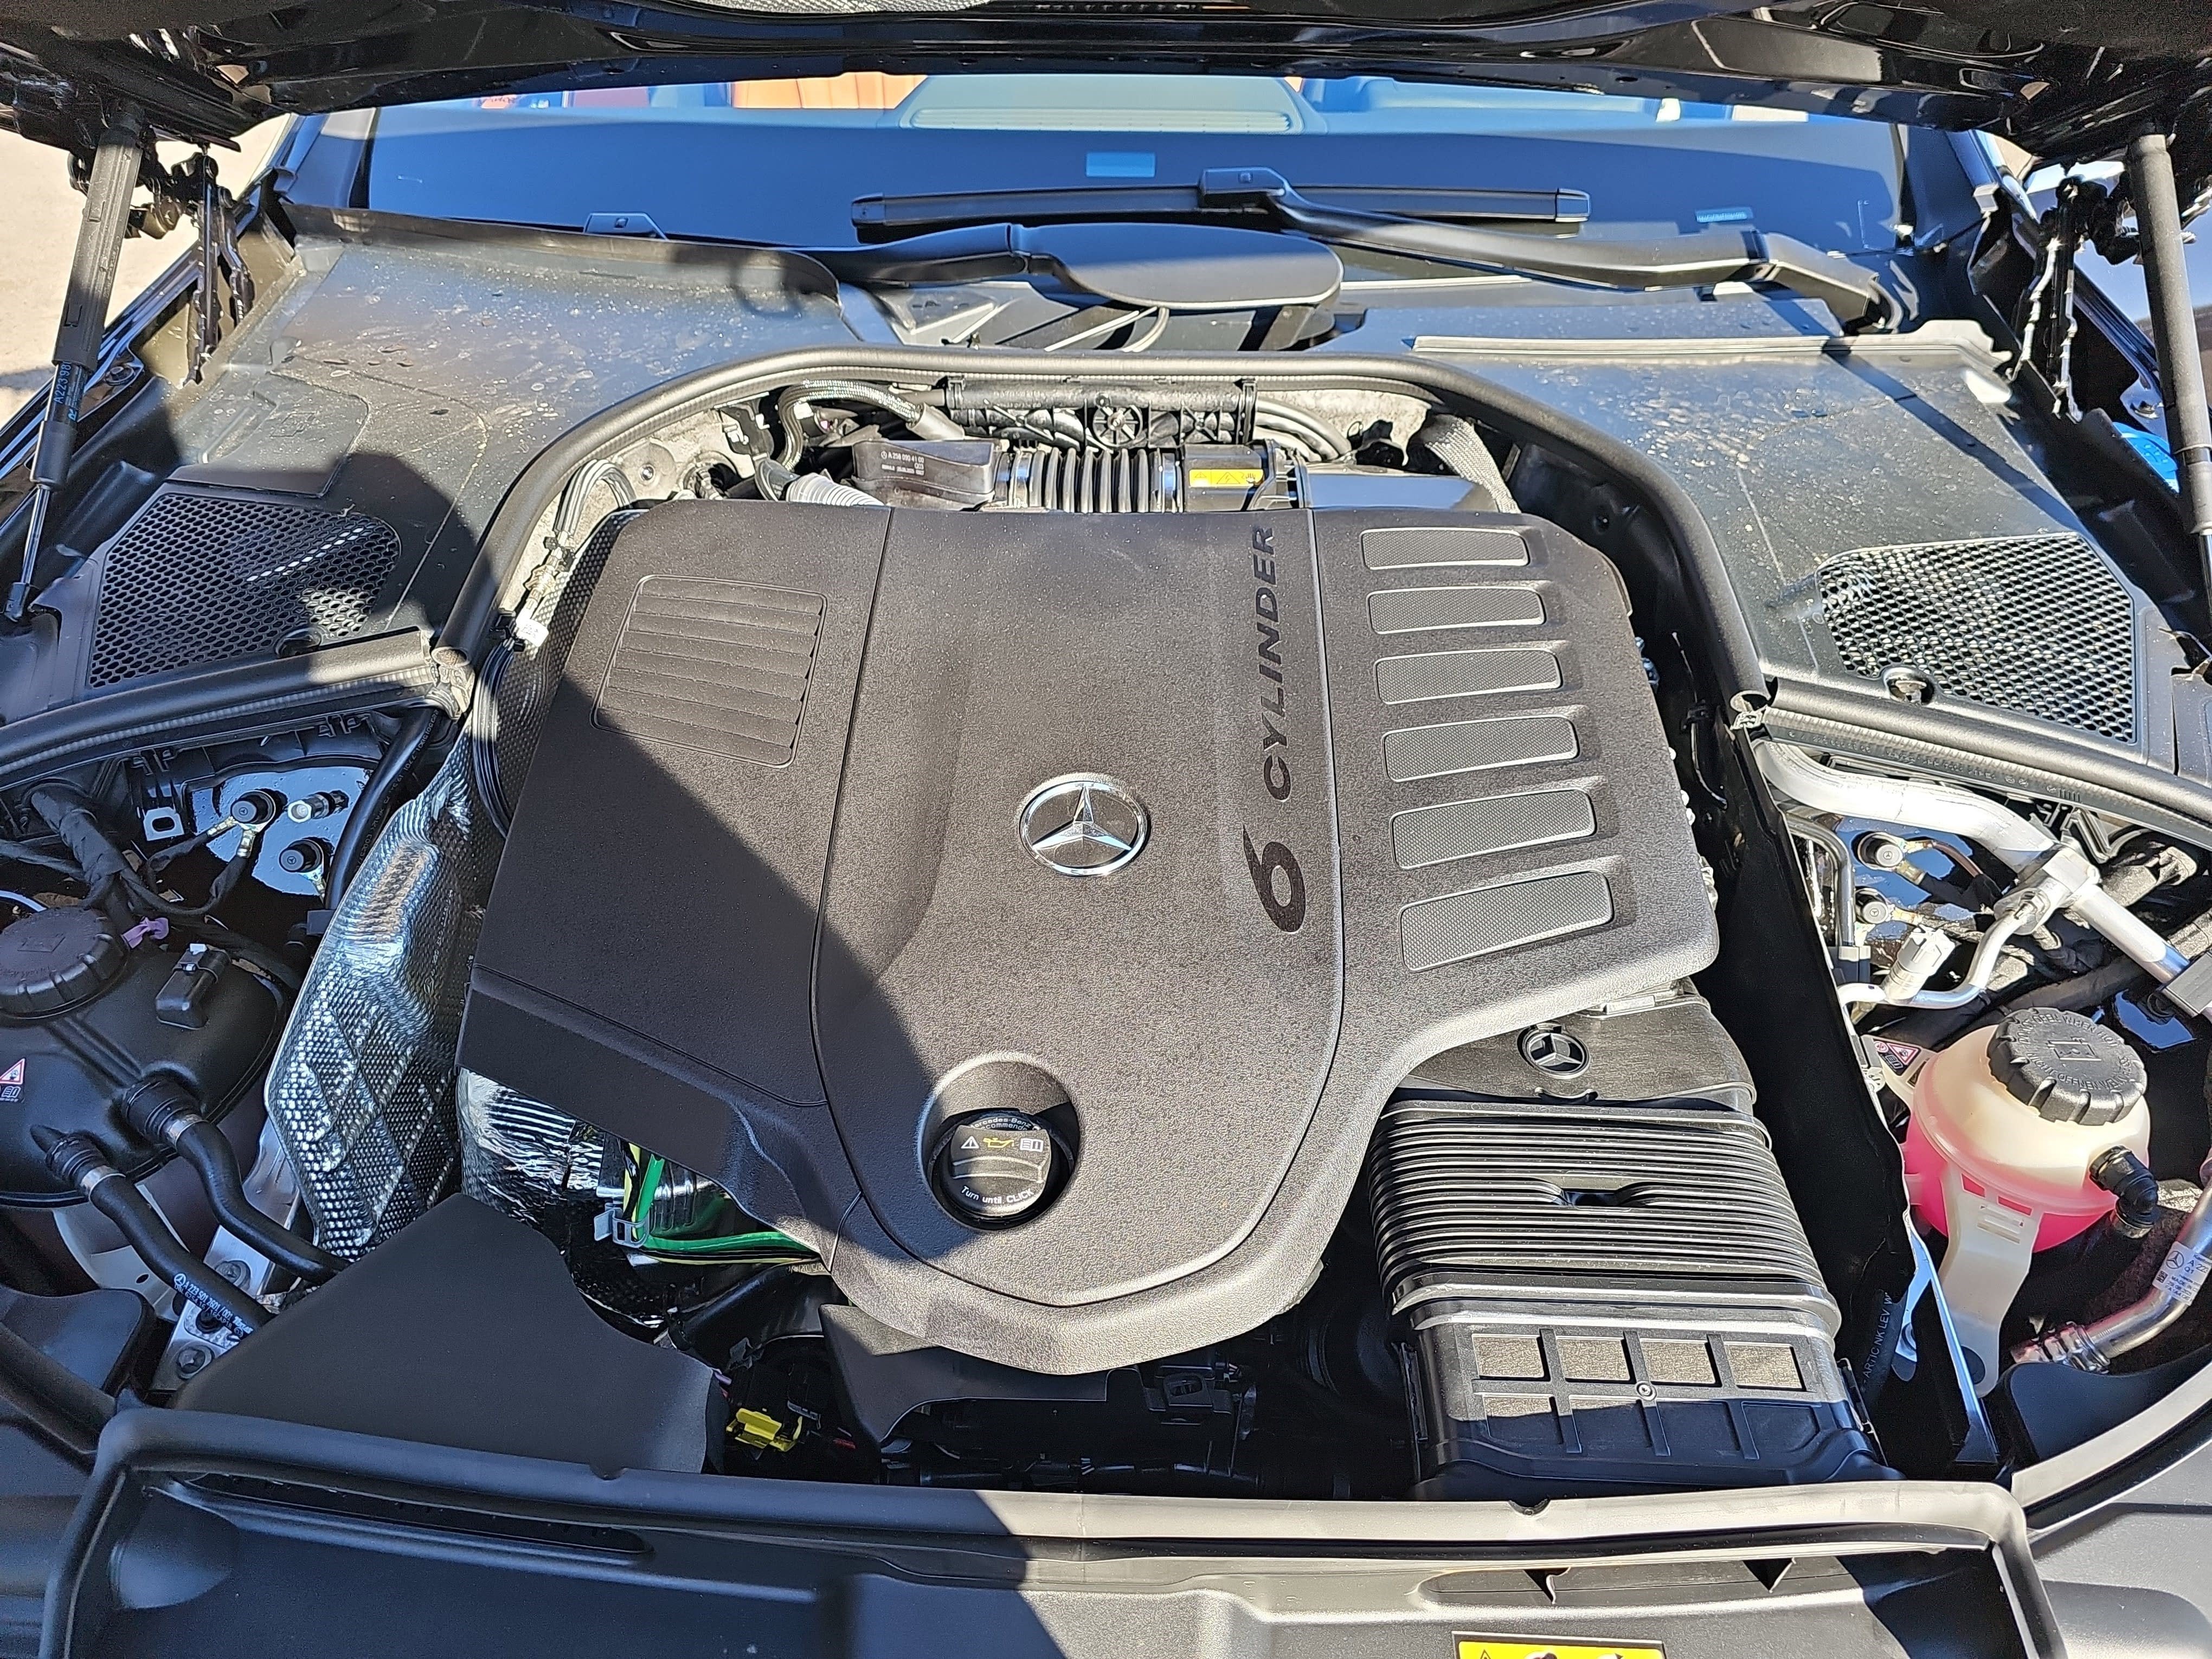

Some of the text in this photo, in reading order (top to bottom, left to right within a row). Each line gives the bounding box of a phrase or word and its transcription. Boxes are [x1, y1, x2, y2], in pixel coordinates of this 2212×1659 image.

[1243, 525, 1306, 933] 6 CYLINDER
[961, 1186, 1034, 1204] Turn until CLICK
[2184, 1266, 2195, 1274] Q1
[183, 1281, 190, 1289] A
[188, 1283, 200, 1296] 223
[197, 1290, 209, 1304] 501
[1878, 1308, 1891, 1329] LEV
[1874, 1329, 1885, 1346] NK
[1863, 1347, 1880, 1379] ARTIC
